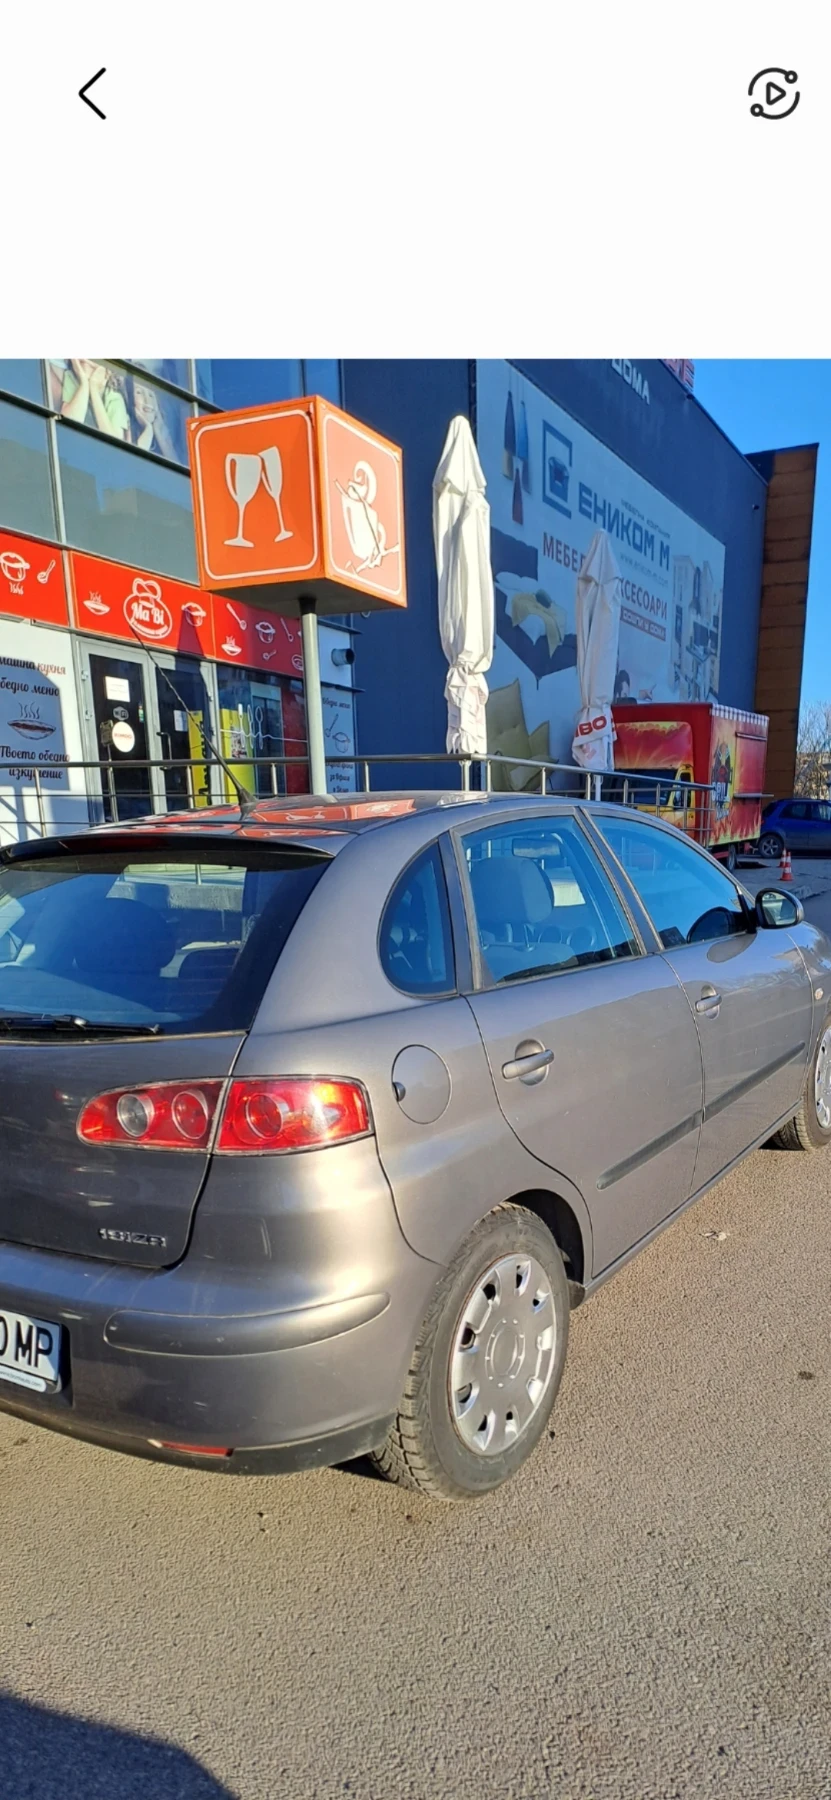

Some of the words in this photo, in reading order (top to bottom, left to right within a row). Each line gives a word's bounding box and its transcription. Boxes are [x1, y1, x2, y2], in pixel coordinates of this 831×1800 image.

[578, 481, 655, 562] ЕНИКОМ
[659, 539, 671, 572] М
[36, 662, 67, 676] кухня
[31, 684, 60, 697] меню
[0, 746, 36, 760] Твоето
[14, 1320, 54, 1369] MP
